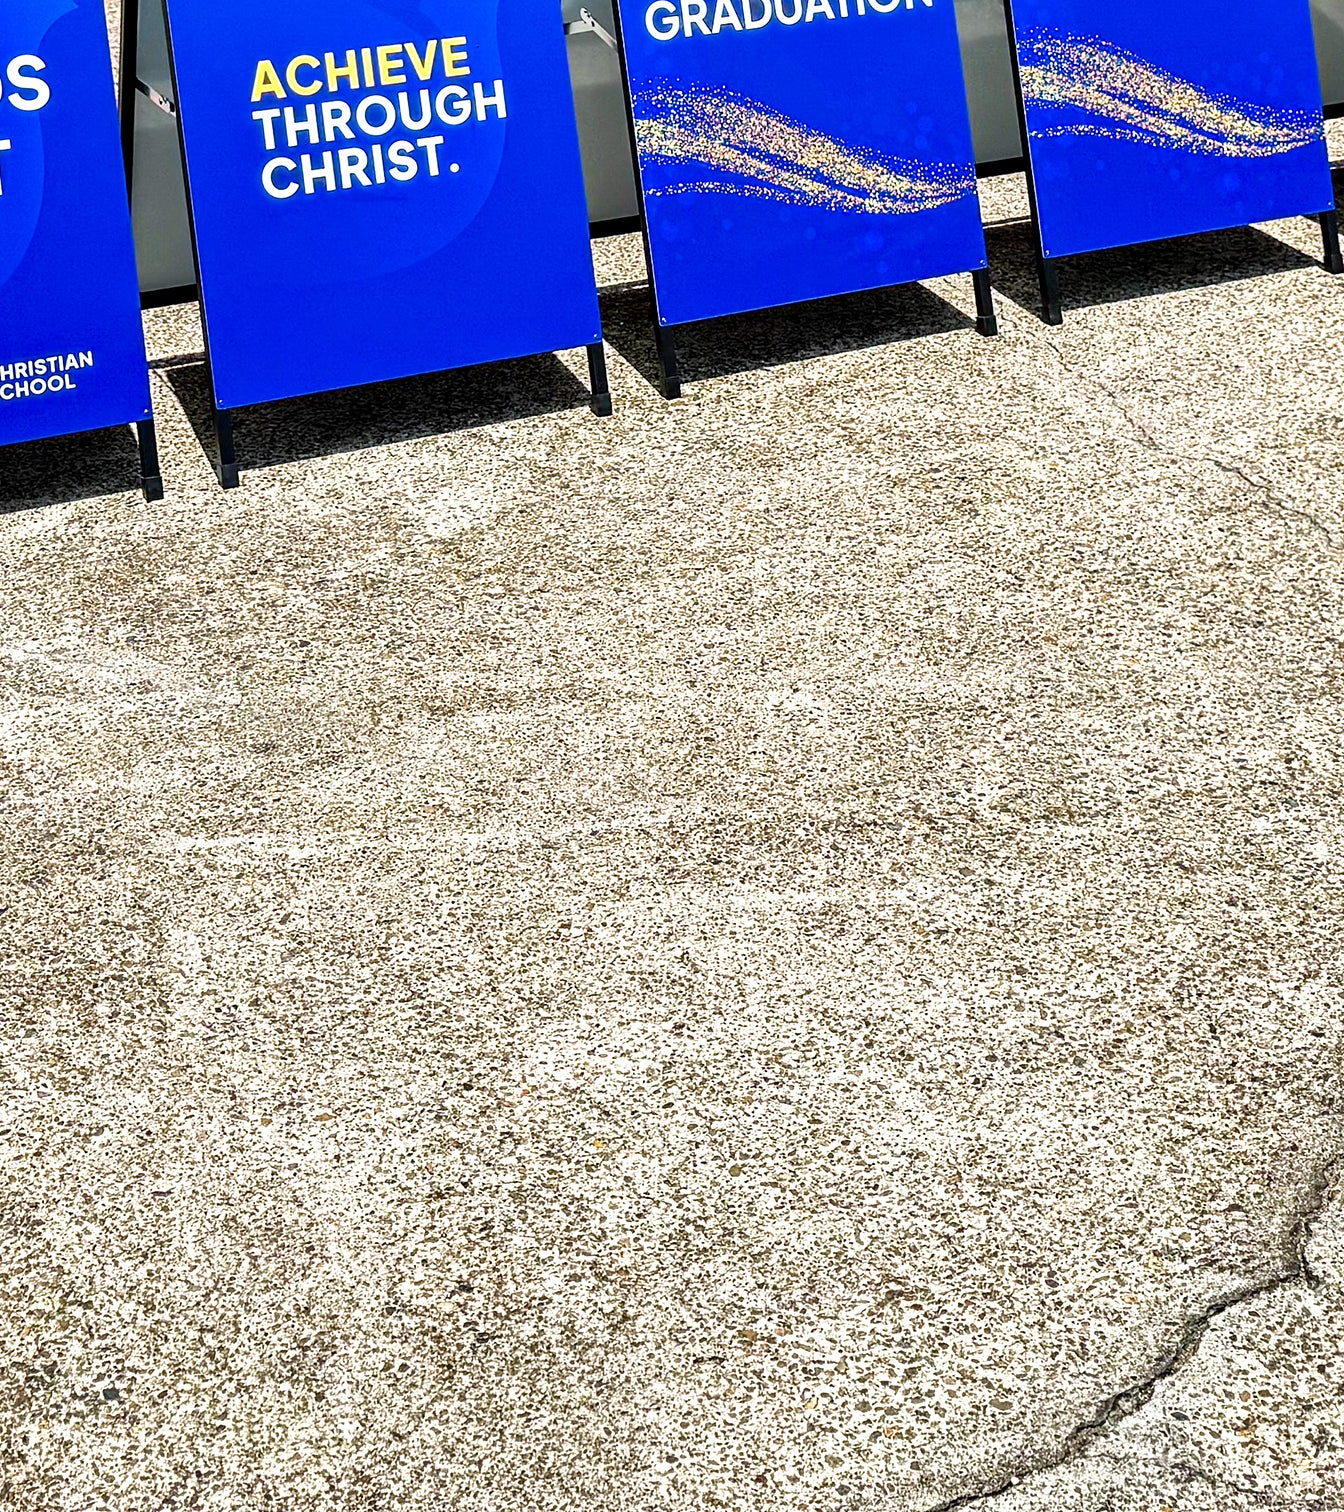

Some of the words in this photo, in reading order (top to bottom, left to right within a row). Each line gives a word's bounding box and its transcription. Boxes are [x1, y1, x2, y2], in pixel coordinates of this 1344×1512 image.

[251, 36, 471, 102] ACHIEVE
[252, 79, 507, 150] THROUGH
[261, 135, 460, 199] CHRIST.
